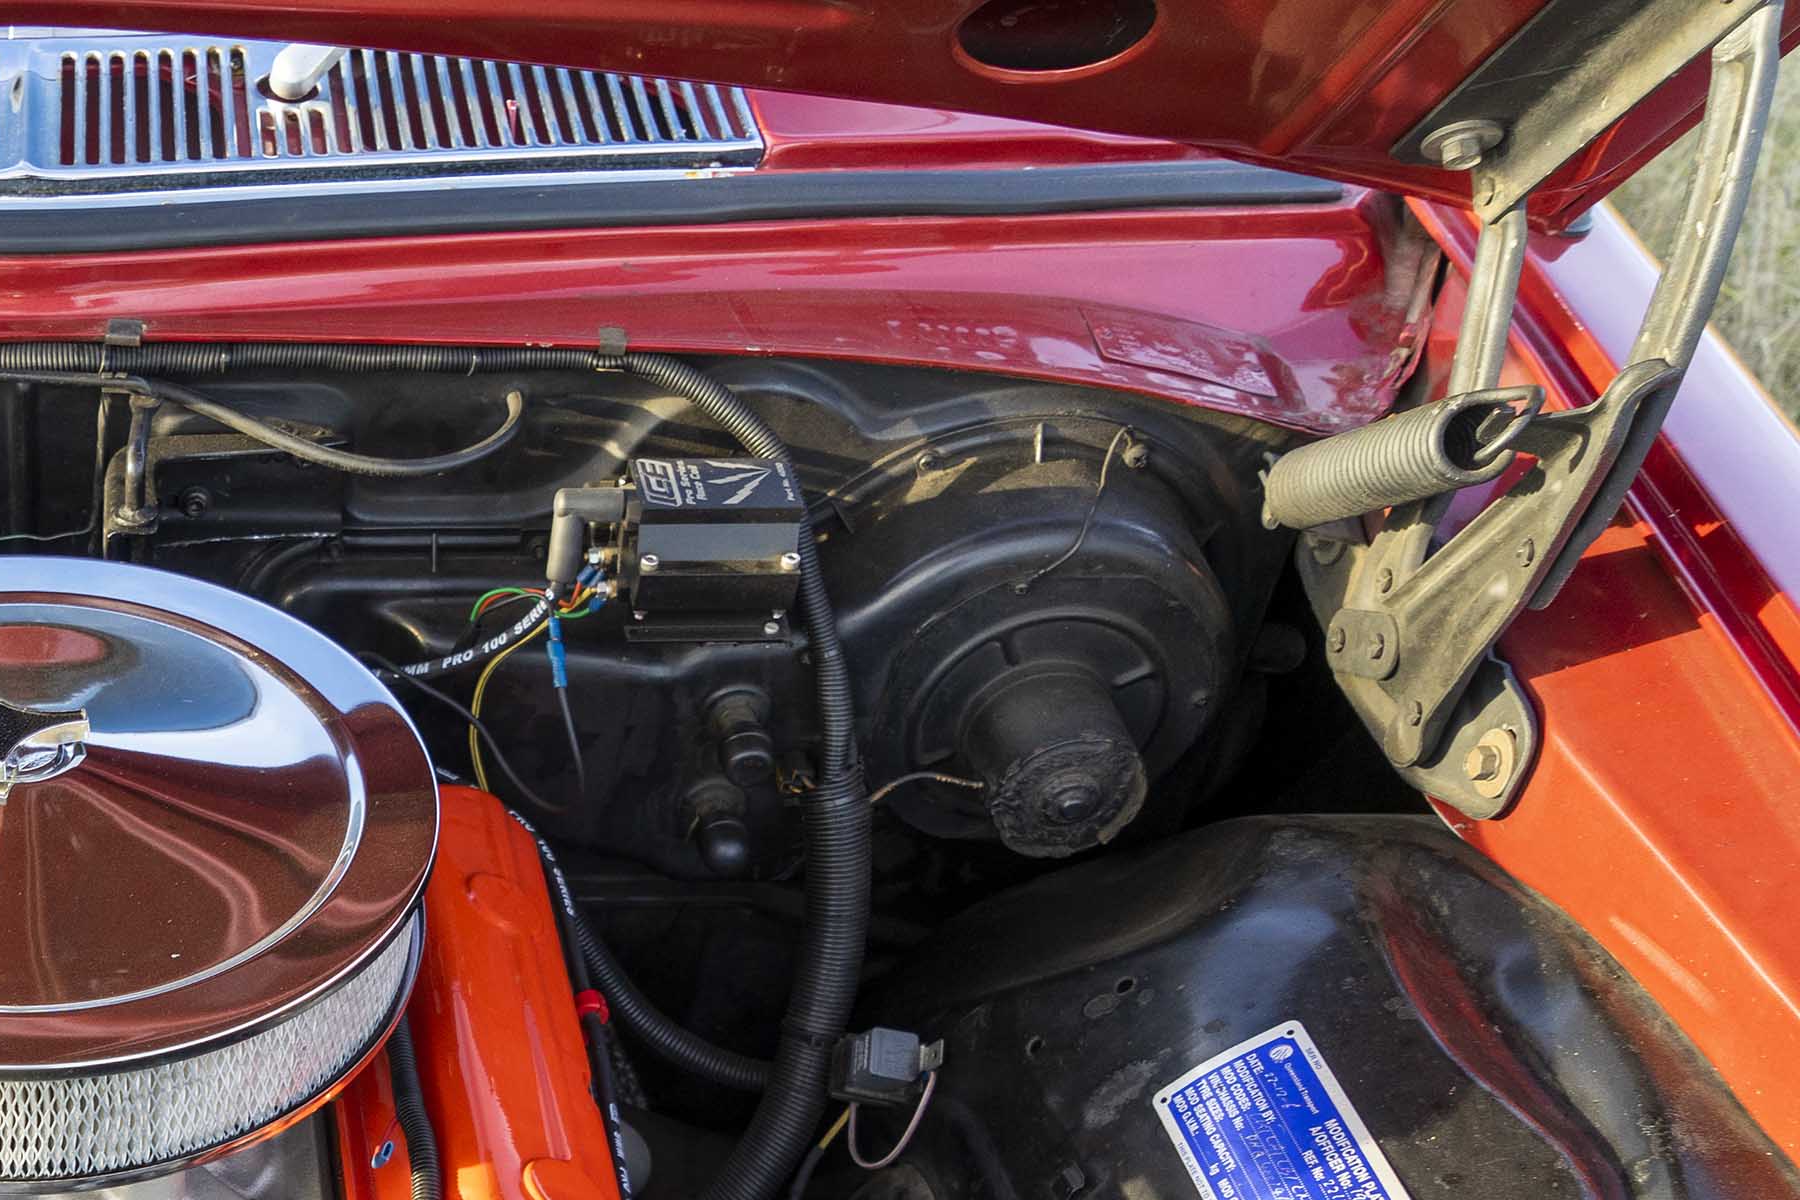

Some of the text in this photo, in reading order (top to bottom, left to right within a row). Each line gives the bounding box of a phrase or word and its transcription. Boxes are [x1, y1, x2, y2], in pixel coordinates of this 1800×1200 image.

[442, 649, 474, 669] PRO
[481, 632, 508, 654] 100
[1195, 1078, 1226, 1122] TYRE SIZES:
[1206, 1071, 1240, 1118] VIN/CHASSIS
[1219, 1065, 1237, 1085] MOD
[1228, 1082, 1252, 1112] CODES:
[1232, 1058, 1269, 1112] MODIFICATION
[1282, 1061, 1319, 1115] Queensland Transport
[1172, 1093, 1189, 1113] MOD
[1206, 1162, 1222, 1176] kg
[1216, 1177, 1235, 1198] MOD
[1183, 1086, 1237, 1173] MOD SEATING CAPACITY:
[1308, 1122, 1346, 1174] A/OFFICER
[1335, 1170, 1356, 1190] No:
[1323, 1116, 1371, 1183] MODIFICATION
